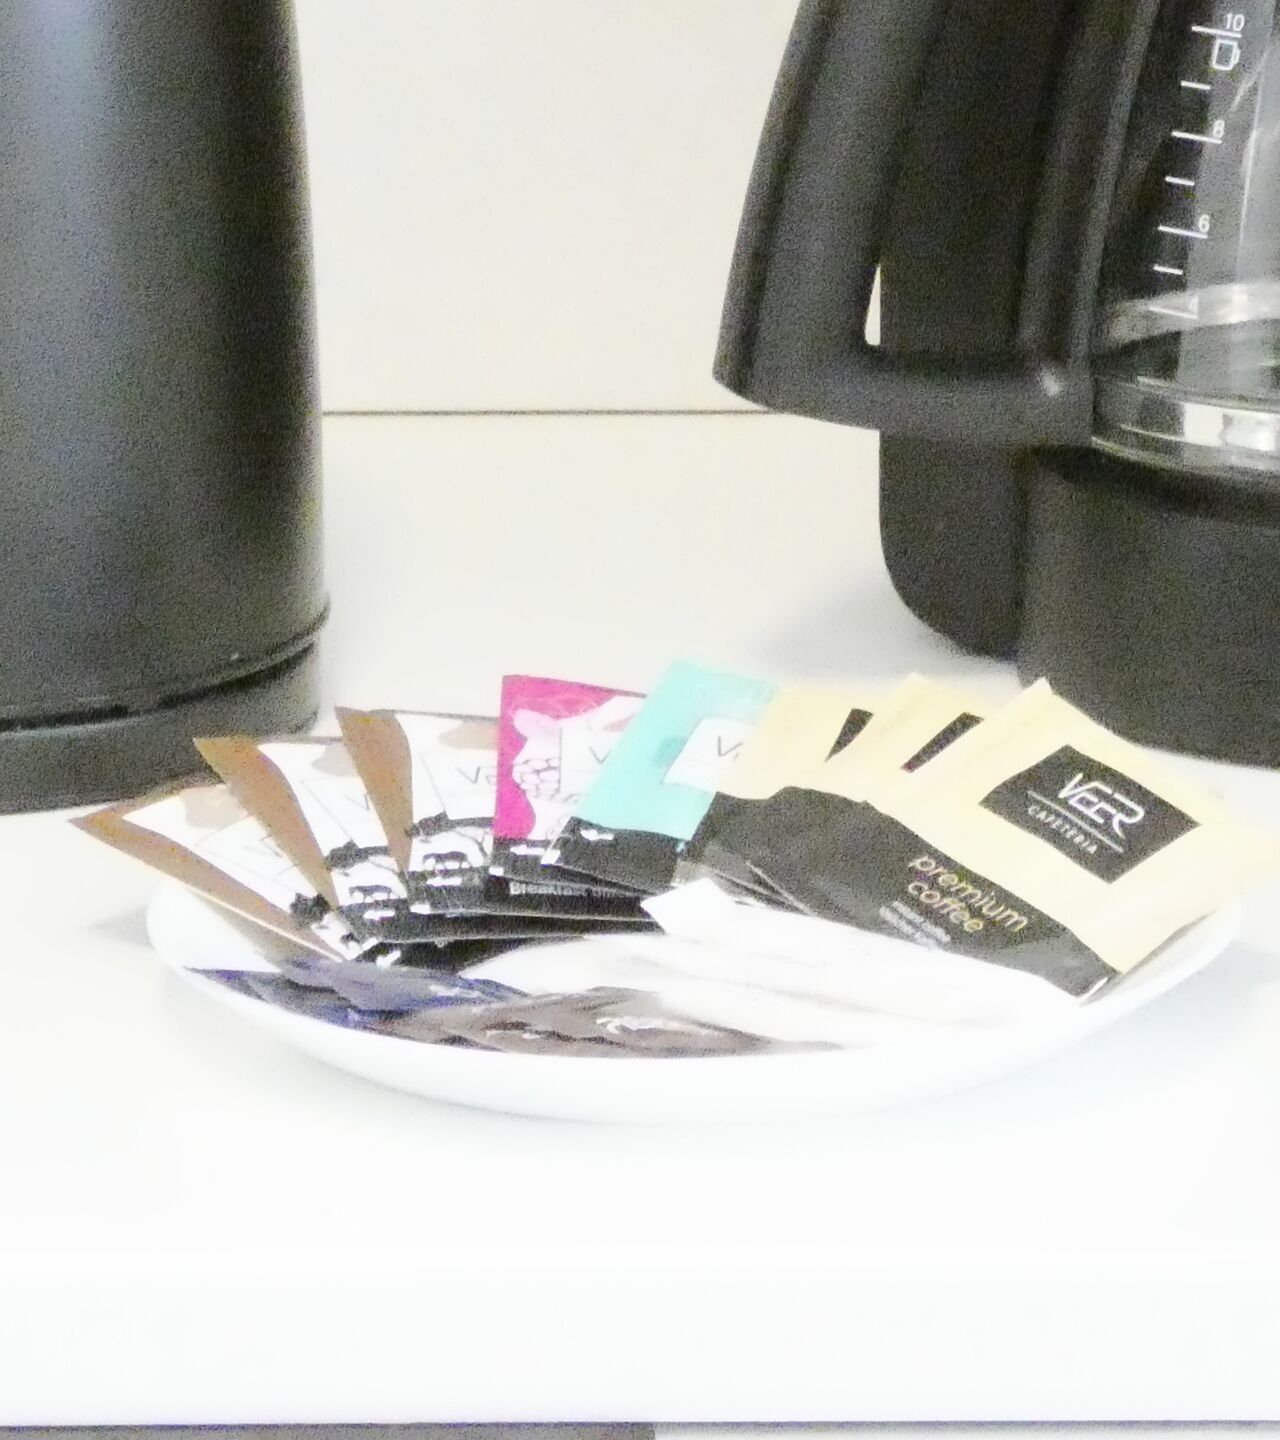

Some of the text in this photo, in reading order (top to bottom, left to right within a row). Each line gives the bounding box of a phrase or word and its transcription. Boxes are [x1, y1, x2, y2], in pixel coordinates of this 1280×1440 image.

[1223, 13, 1245, 32] 10
[1212, 119, 1225, 138] 8
[1198, 214, 1210, 233] 6
[1027, 804, 1098, 855] CAFETERIA
[1058, 773, 1145, 839] VEER
[908, 855, 1028, 932] premium
[908, 881, 984, 933] coffee
